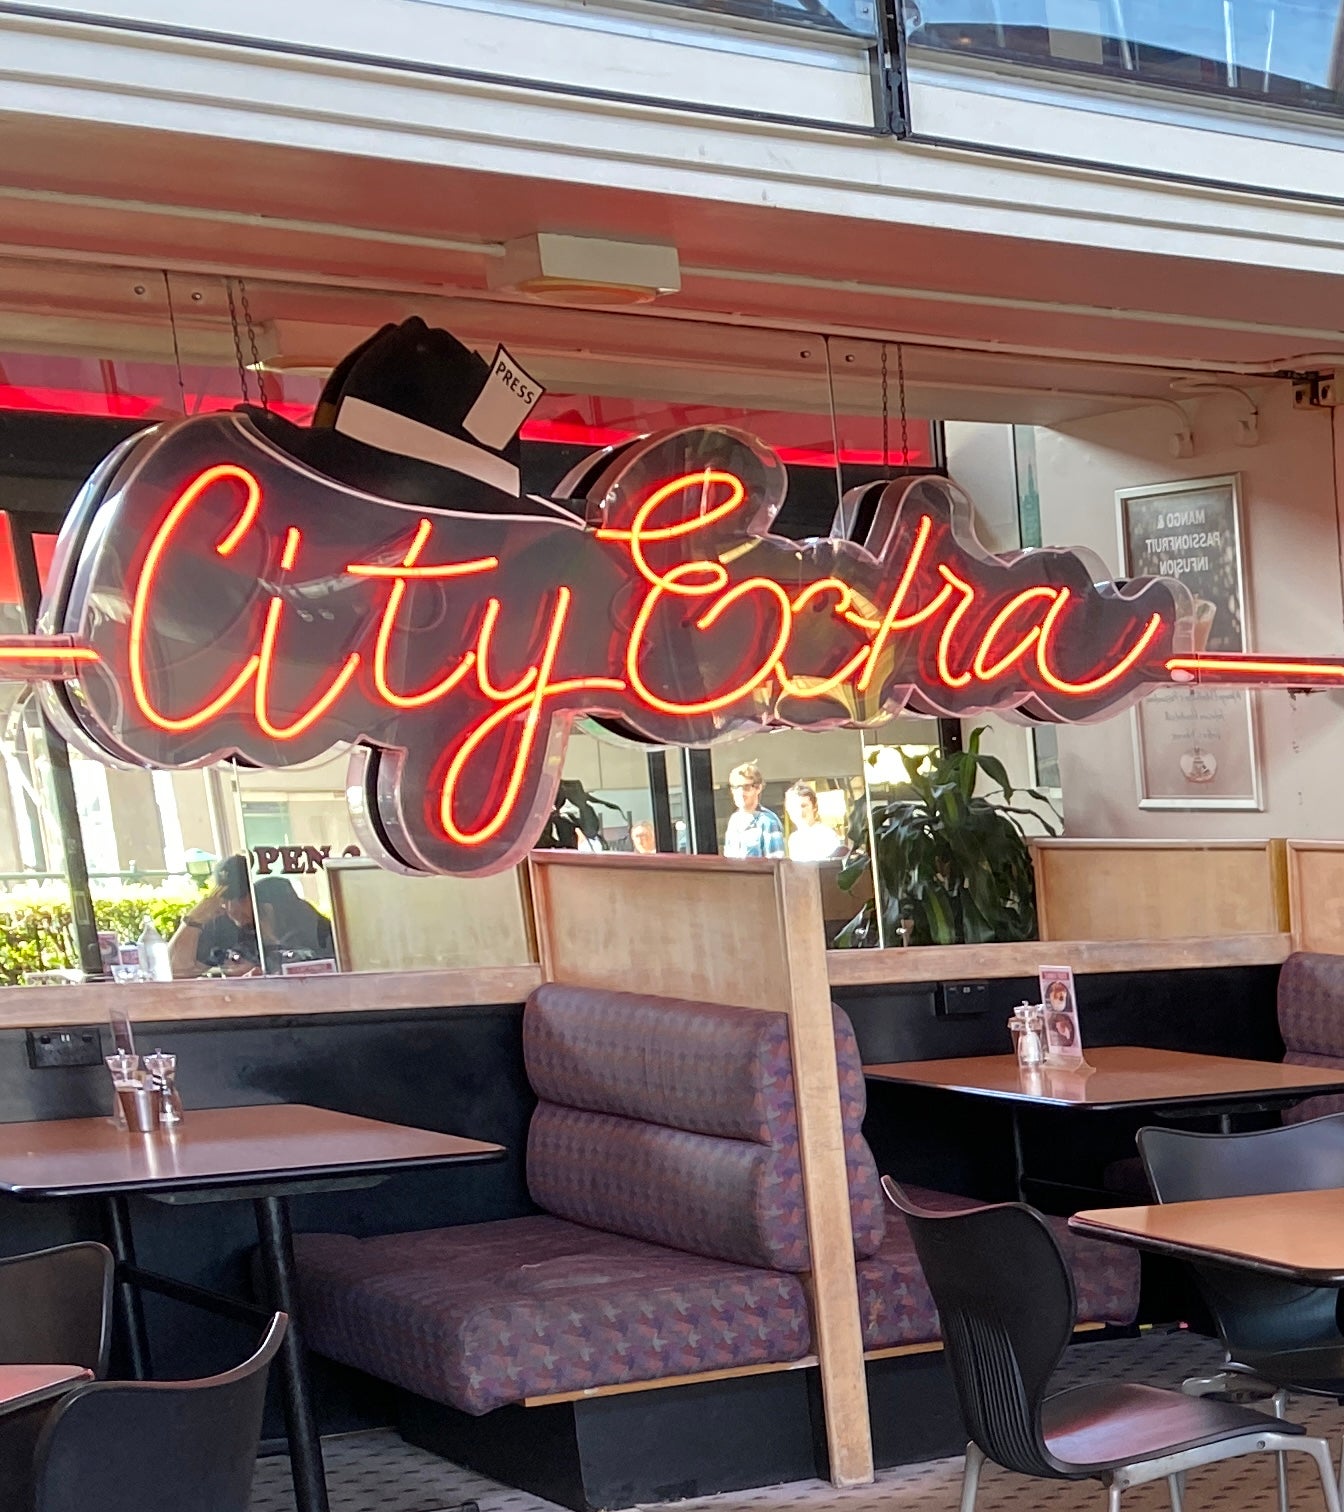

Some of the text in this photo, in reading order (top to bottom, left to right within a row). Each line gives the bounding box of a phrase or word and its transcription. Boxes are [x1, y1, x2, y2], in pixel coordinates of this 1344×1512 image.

[495, 361, 535, 405] PRESS
[129, 462, 1162, 846] City Extra
[249, 845, 332, 875] PEN
